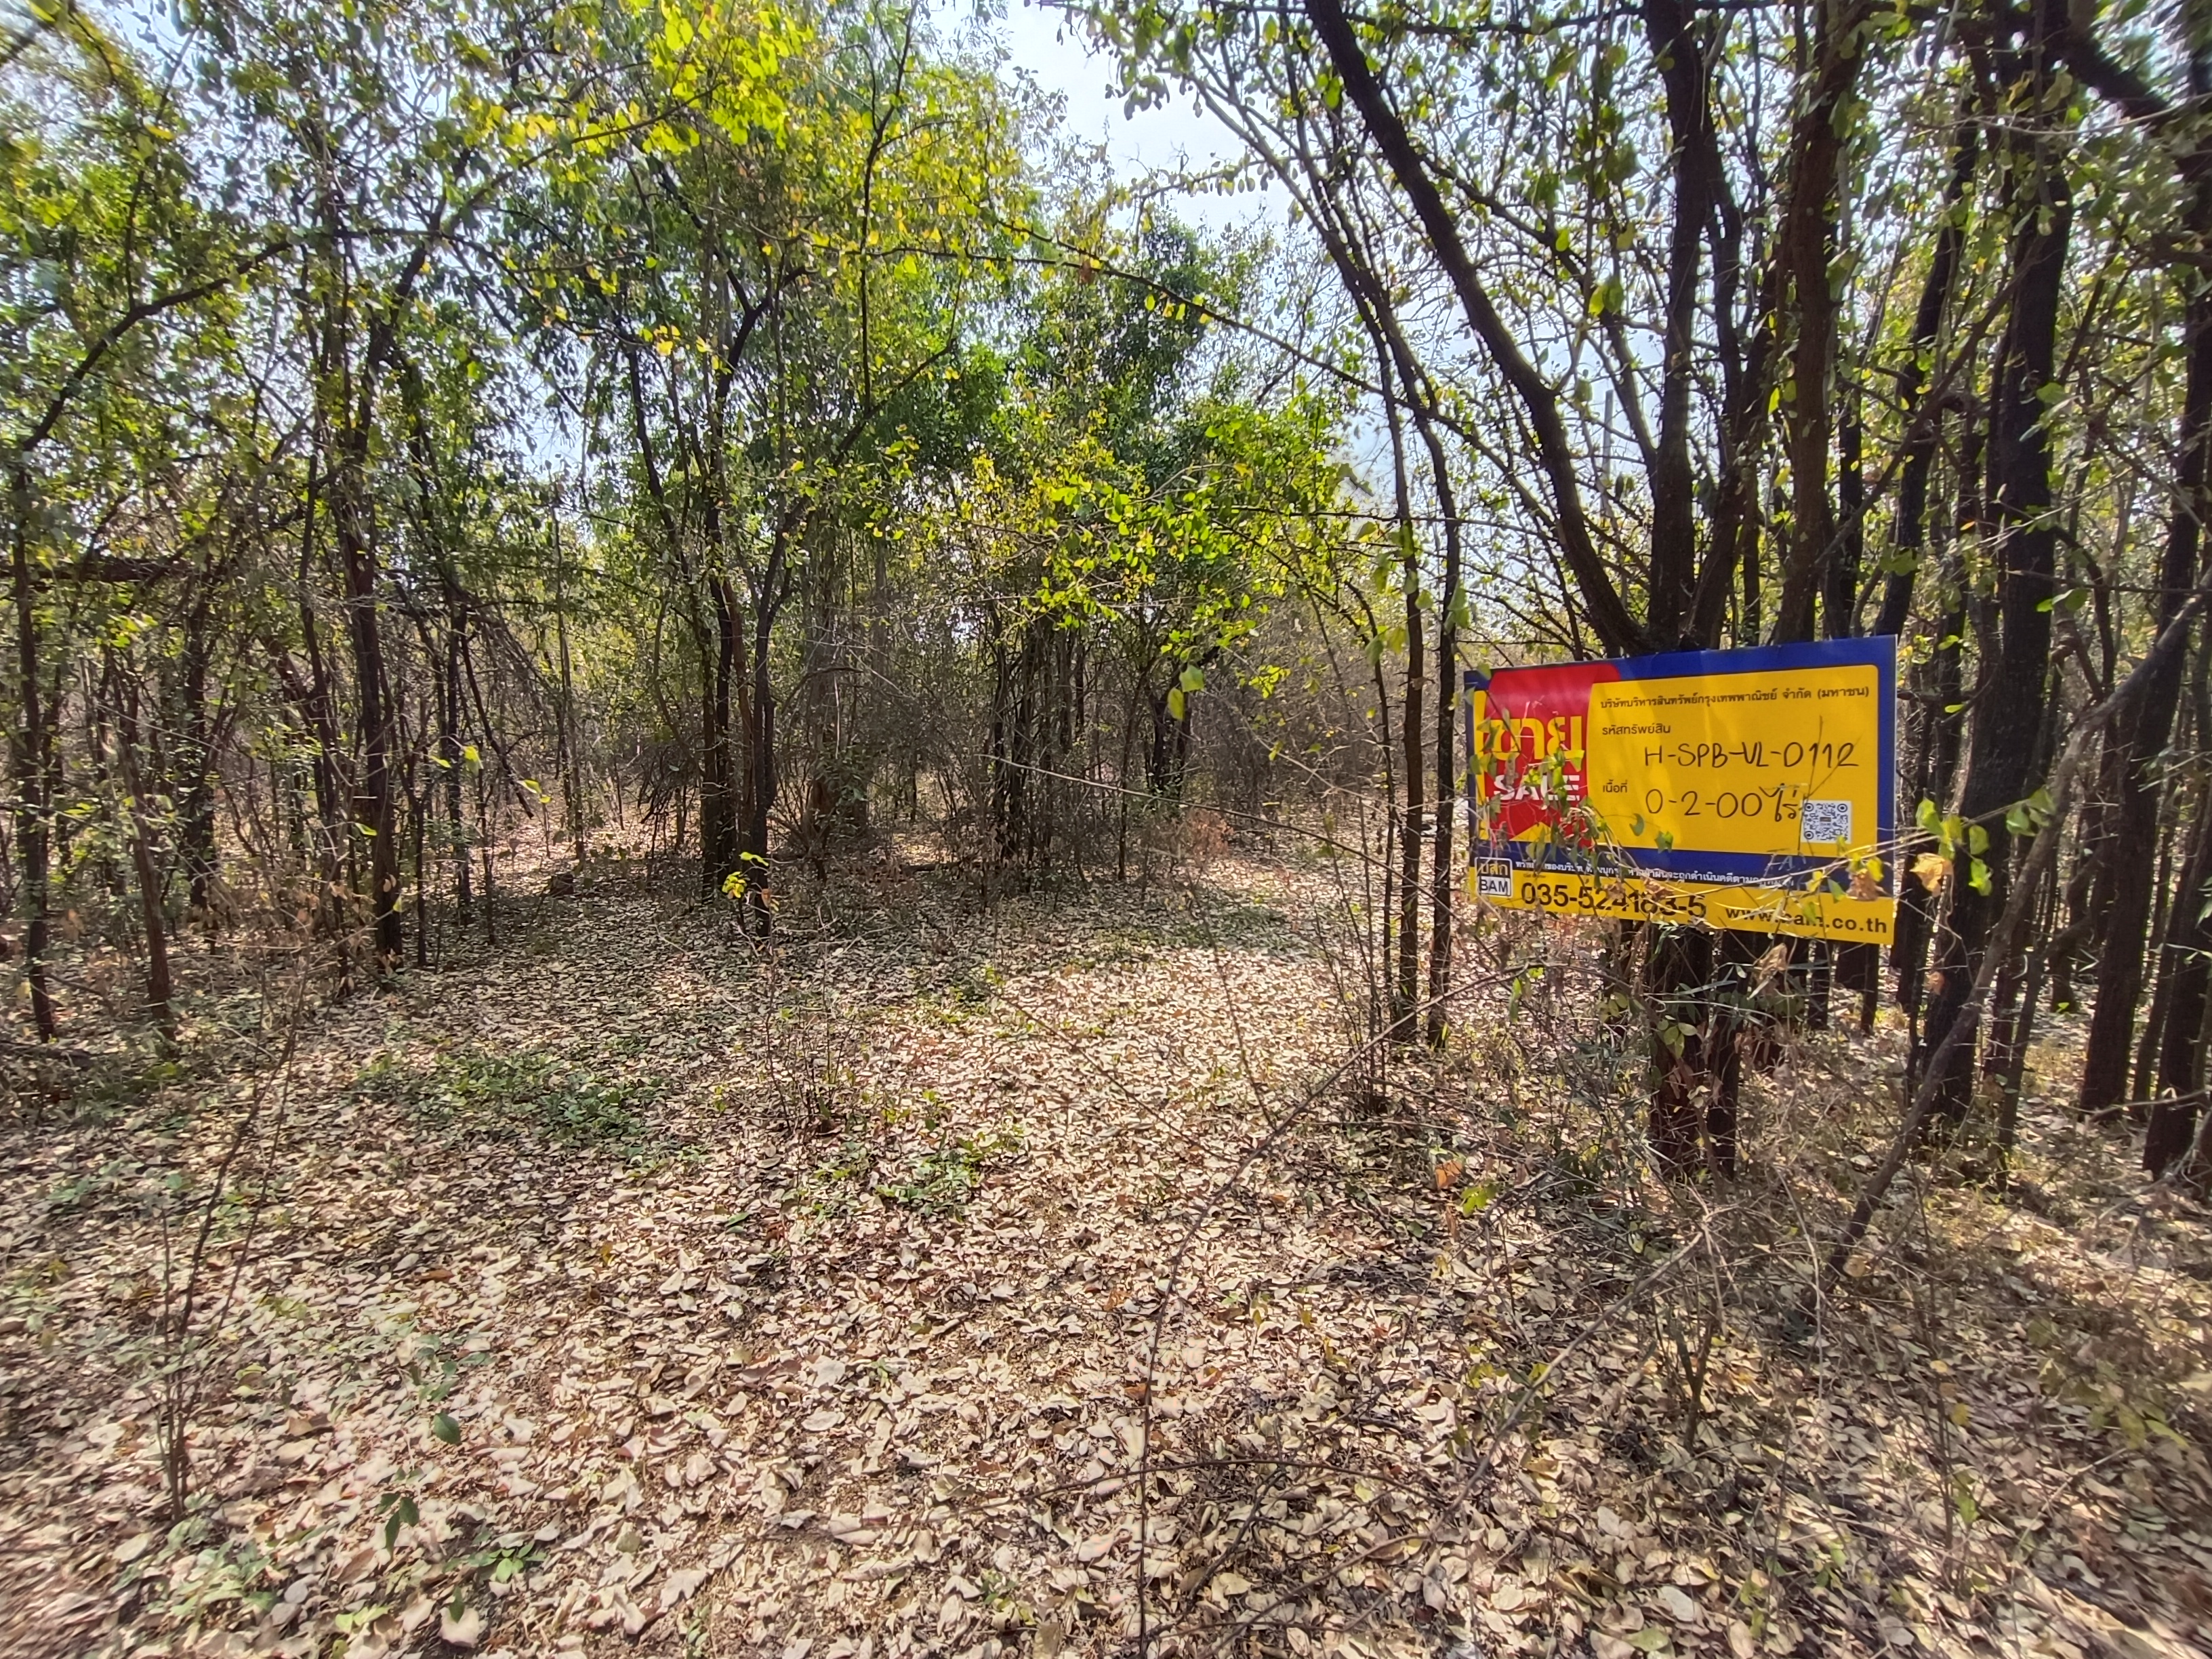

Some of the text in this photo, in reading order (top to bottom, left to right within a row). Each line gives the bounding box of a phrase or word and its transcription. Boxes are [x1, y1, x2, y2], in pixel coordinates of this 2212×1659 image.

[1600, 686, 1870, 709] บริษัทบริหารสินทรัพย์กรุงเทพพาณิชย์ จำกัด (มหาชน)
[1601, 722, 1671, 735] รหัสทรัพย์สิน
[1602, 780, 1628, 794] เนื้อที่
[1480, 861, 1509, 876] บสก
[1480, 879, 1509, 893] BAM
